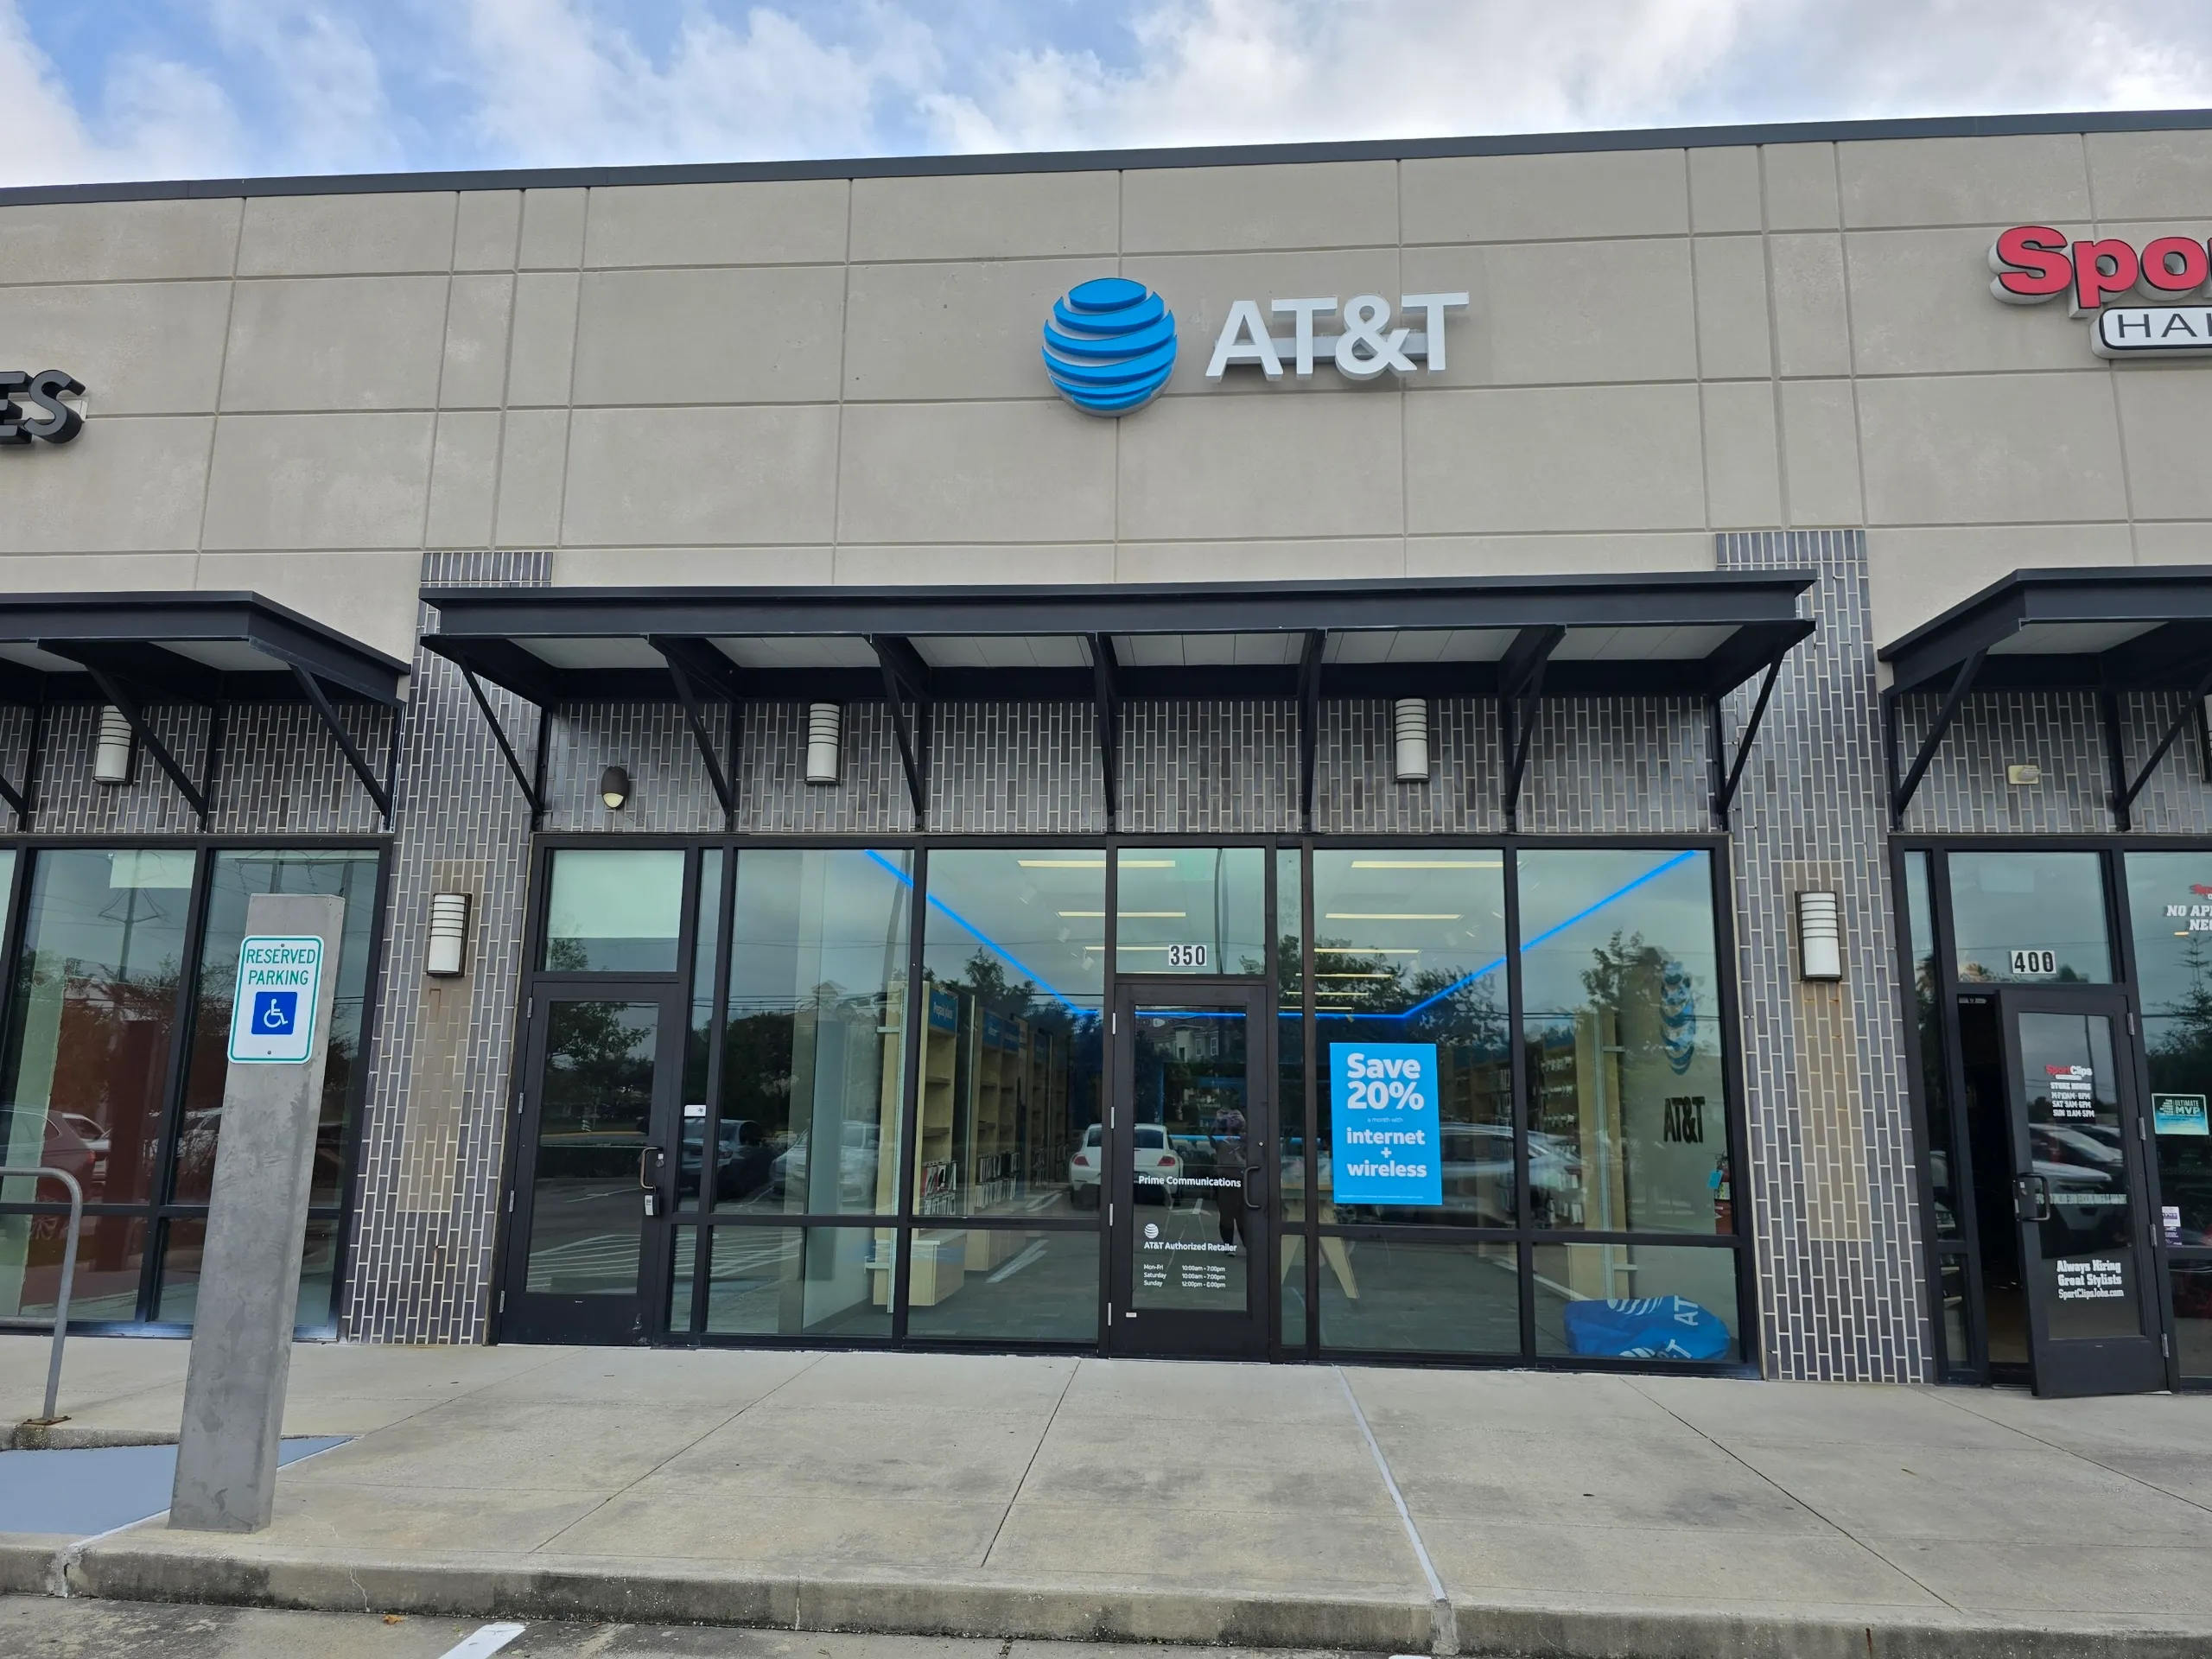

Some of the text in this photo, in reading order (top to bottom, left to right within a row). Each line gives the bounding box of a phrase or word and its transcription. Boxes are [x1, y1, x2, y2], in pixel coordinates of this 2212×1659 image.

[1995, 226, 2212, 309] Spo
[1205, 290, 1469, 380] AT&T
[2166, 905, 2212, 917] NO AP
[2189, 918, 2212, 931] NE
[246, 949, 315, 964] RESERVED
[1171, 945, 1205, 965] 350
[2014, 951, 2054, 973] 400
[248, 969, 308, 985] PARKING
[1347, 1052, 1421, 1079] Save
[1347, 1080, 1425, 1110] 20%
[2175, 1106, 2201, 1115] MVP
[1663, 1096, 1706, 1143] AT&T
[1346, 1127, 1426, 1145] internet
[1380, 1147, 1392, 1159] +
[1346, 1160, 1427, 1178] wireless
[1138, 1175, 1242, 1188] Prime Communications
[1165, 1242, 1207, 1251] Authorized
[1207, 1243, 1237, 1252] Retailer
[2056, 1259, 2121, 1274] Always Hiring
[2057, 1273, 2122, 1287] Great Stylists
[2058, 1287, 2125, 1300] SportClipsJobs.com
